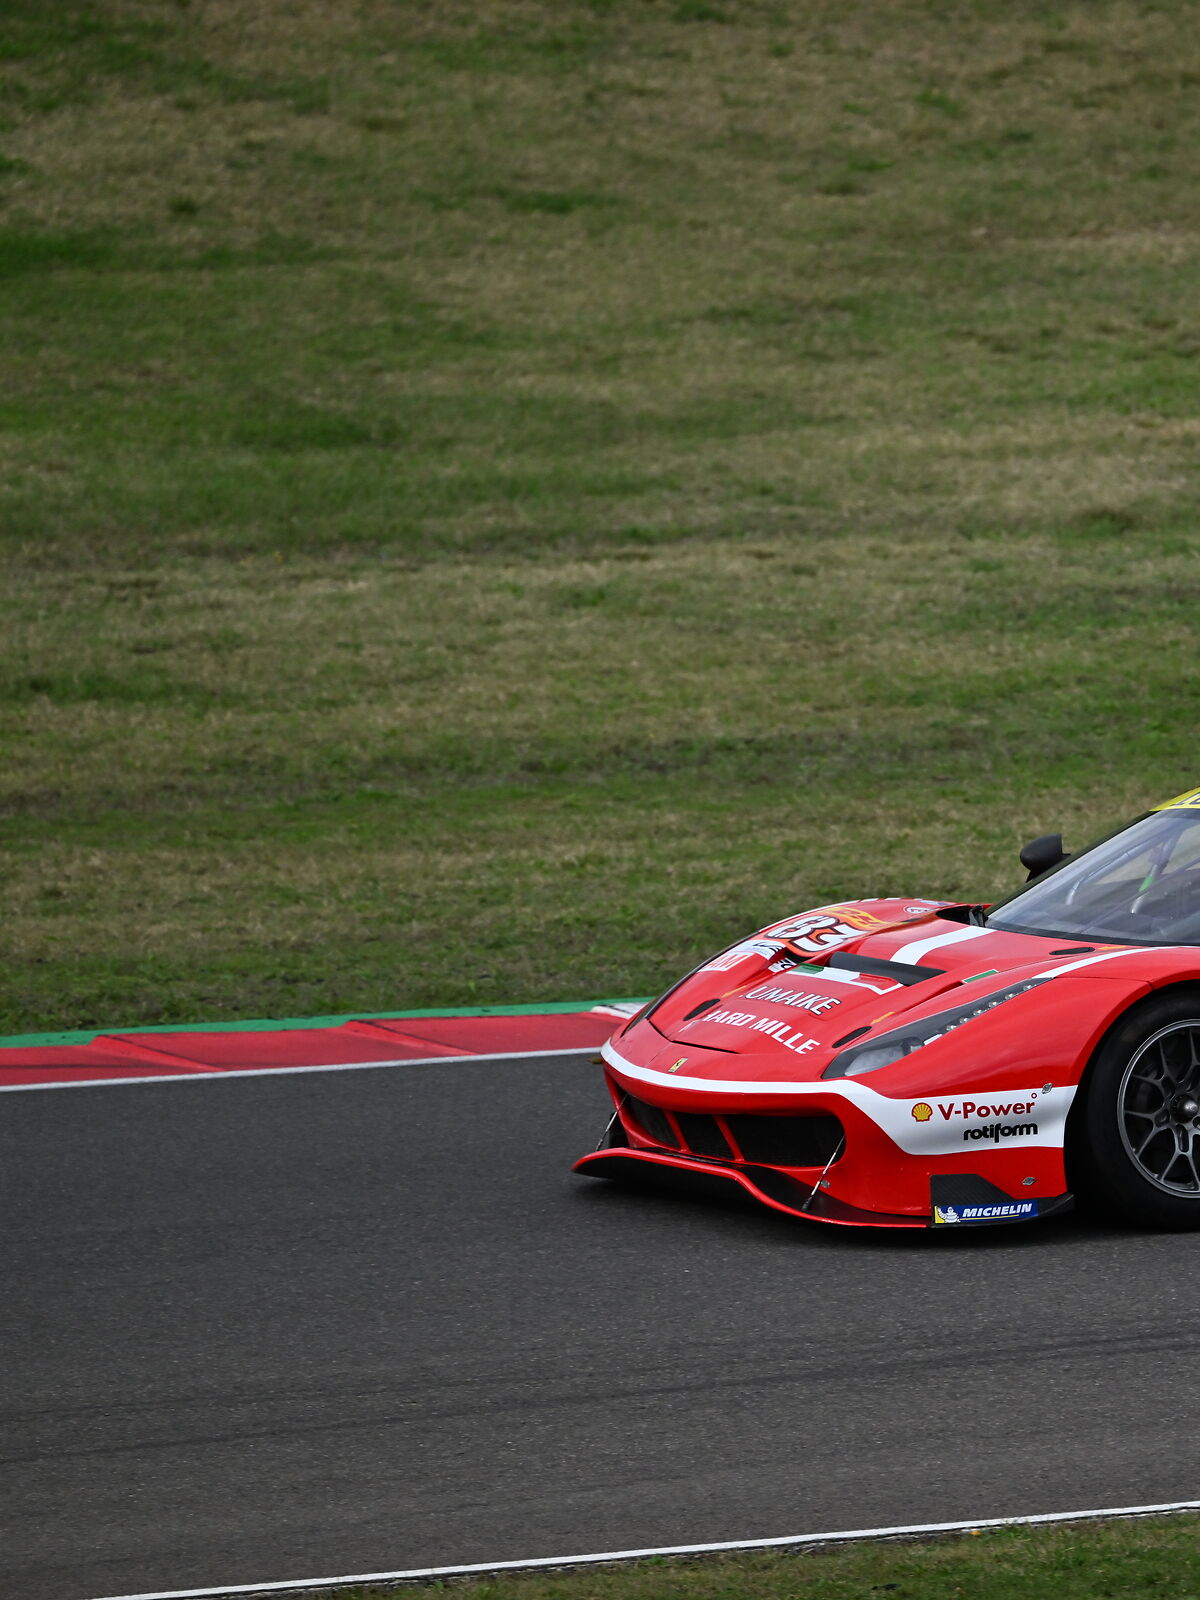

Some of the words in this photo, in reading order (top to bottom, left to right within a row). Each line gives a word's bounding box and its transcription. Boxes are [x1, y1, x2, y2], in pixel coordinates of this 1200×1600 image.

[764, 915, 870, 953] 83
[738, 985, 842, 1016] UMAIKE
[702, 1010, 753, 1027] HARD
[749, 1017, 821, 1056] MILLE
[937, 1101, 1036, 1121] V-Power
[963, 1123, 1038, 1143] rotiform
[962, 1203, 1032, 1217] MICHELIN
